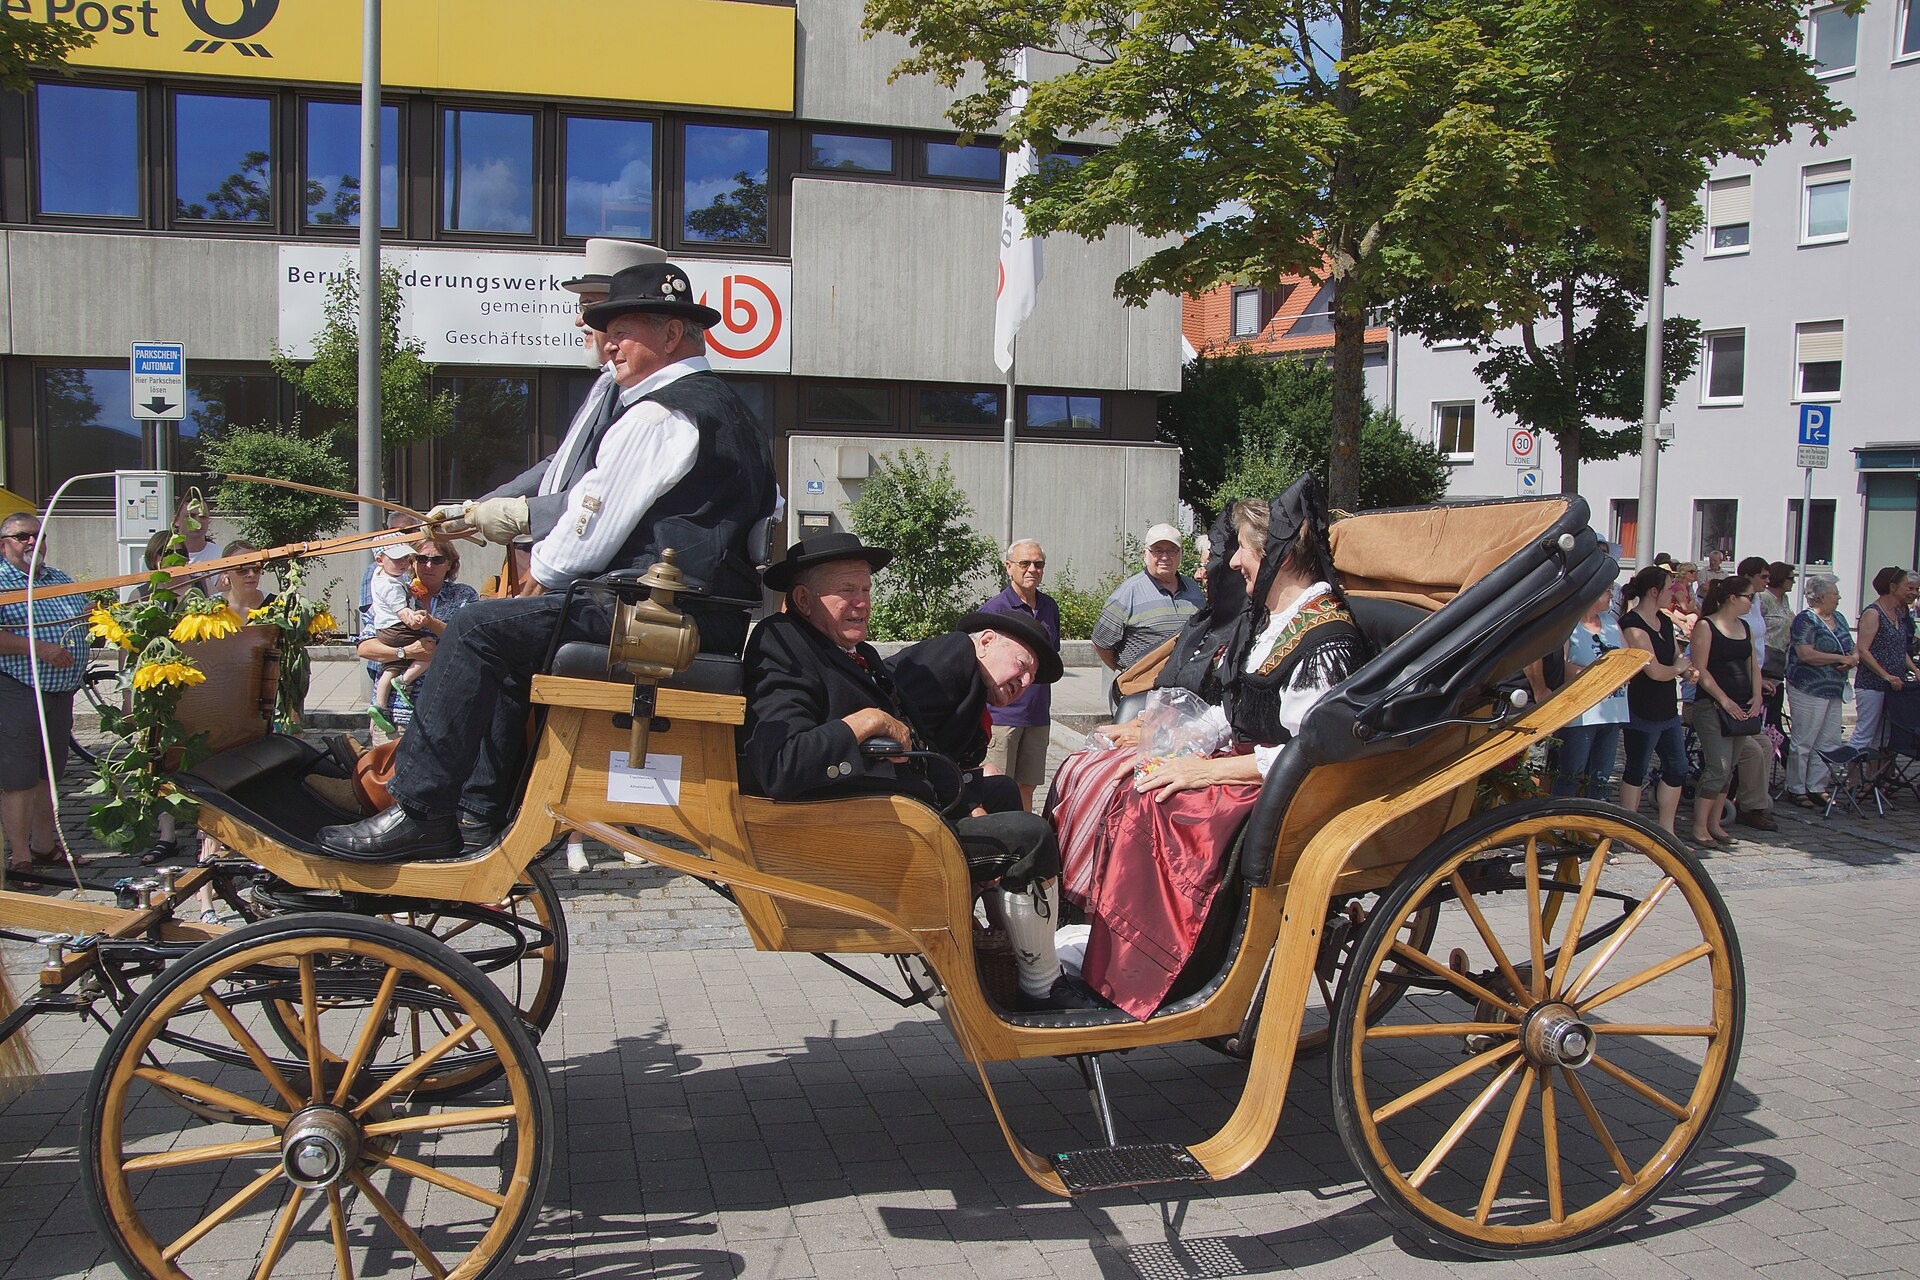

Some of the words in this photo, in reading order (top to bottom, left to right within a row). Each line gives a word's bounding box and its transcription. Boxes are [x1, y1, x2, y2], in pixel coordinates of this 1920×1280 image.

[47, 0, 159, 37] Post
[288, 266, 560, 293] Berurderungswerk
[480, 300, 580, 315] gemeinnüt
[445, 330, 584, 347] Geschäftsstelle
[135, 349, 180, 359] PARKSCHEIN-
[141, 361, 174, 371] AUTOMAT
[149, 377, 181, 385] Parkschein
[1805, 409, 1824, 440] P
[1516, 438, 1530, 450] 30
